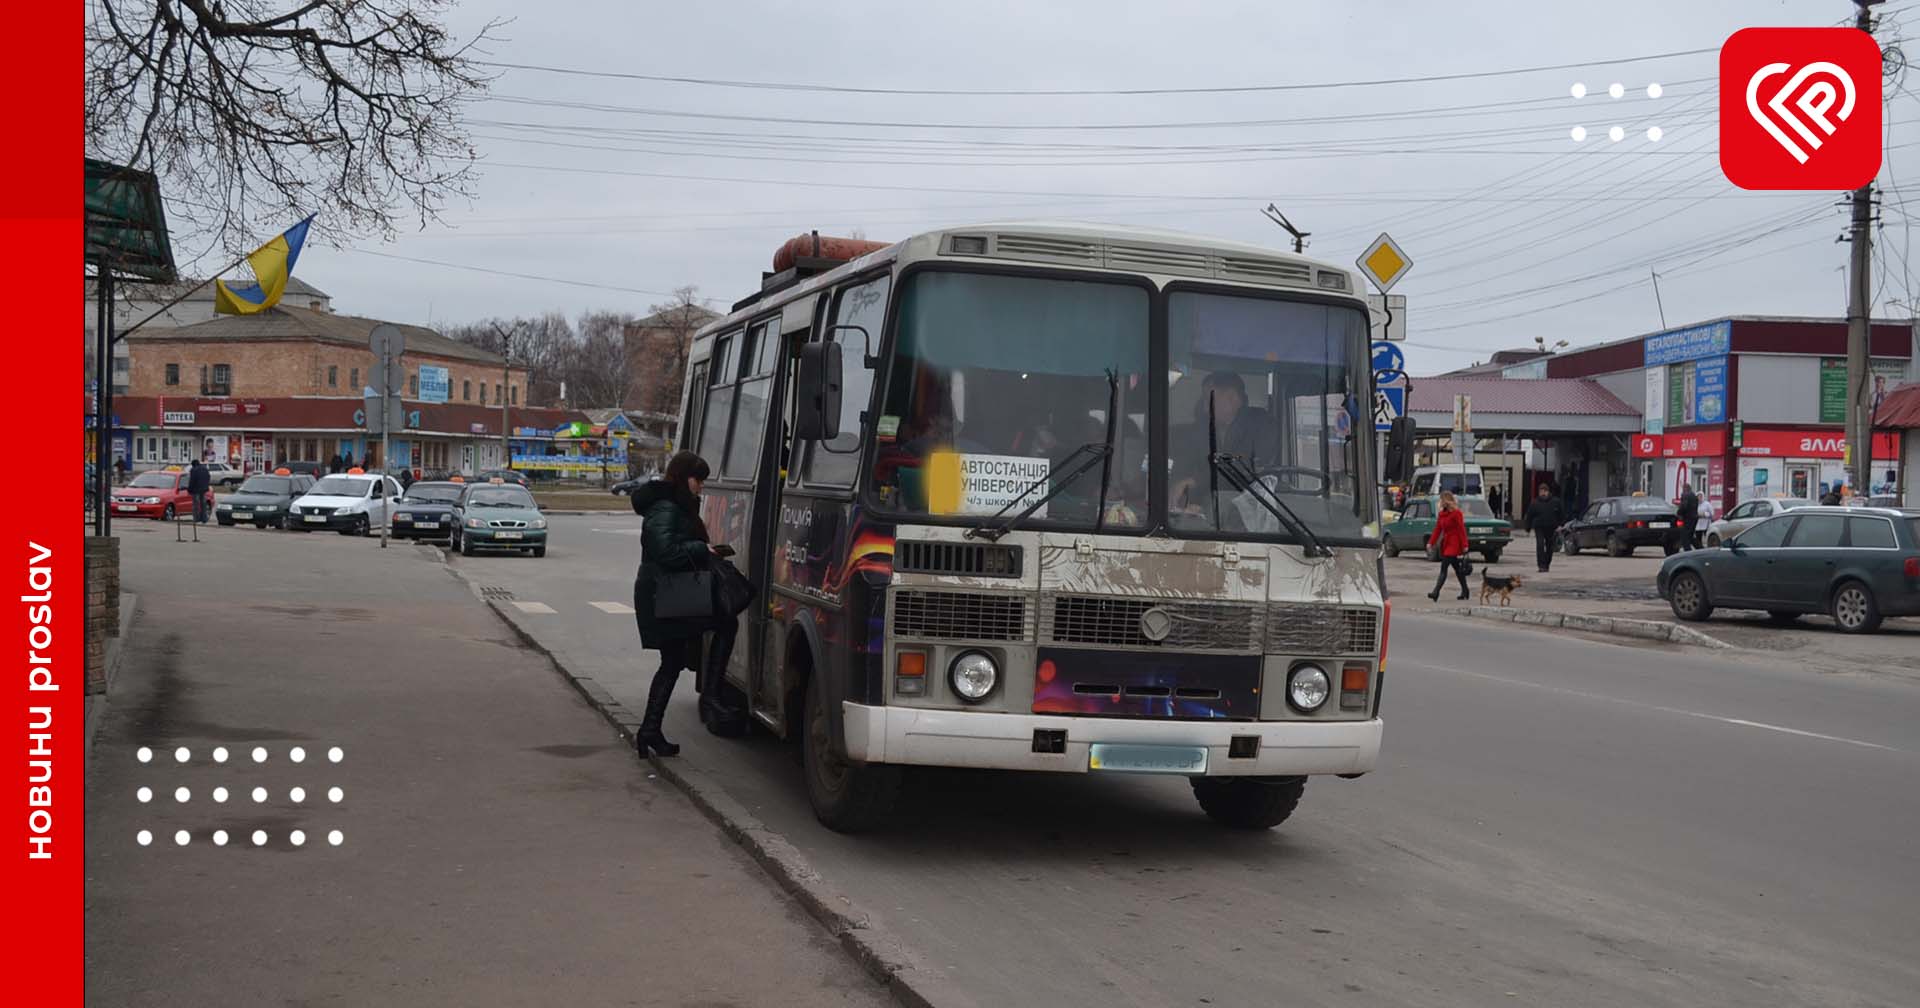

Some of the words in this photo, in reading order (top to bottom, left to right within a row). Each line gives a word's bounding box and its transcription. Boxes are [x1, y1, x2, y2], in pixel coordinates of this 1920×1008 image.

[165, 412, 193, 420] АПТЕКА
[960, 460, 1048, 480] АВТОСТАНЦІЯ
[961, 478, 1047, 496] УНІВЕРСИТЕТ
